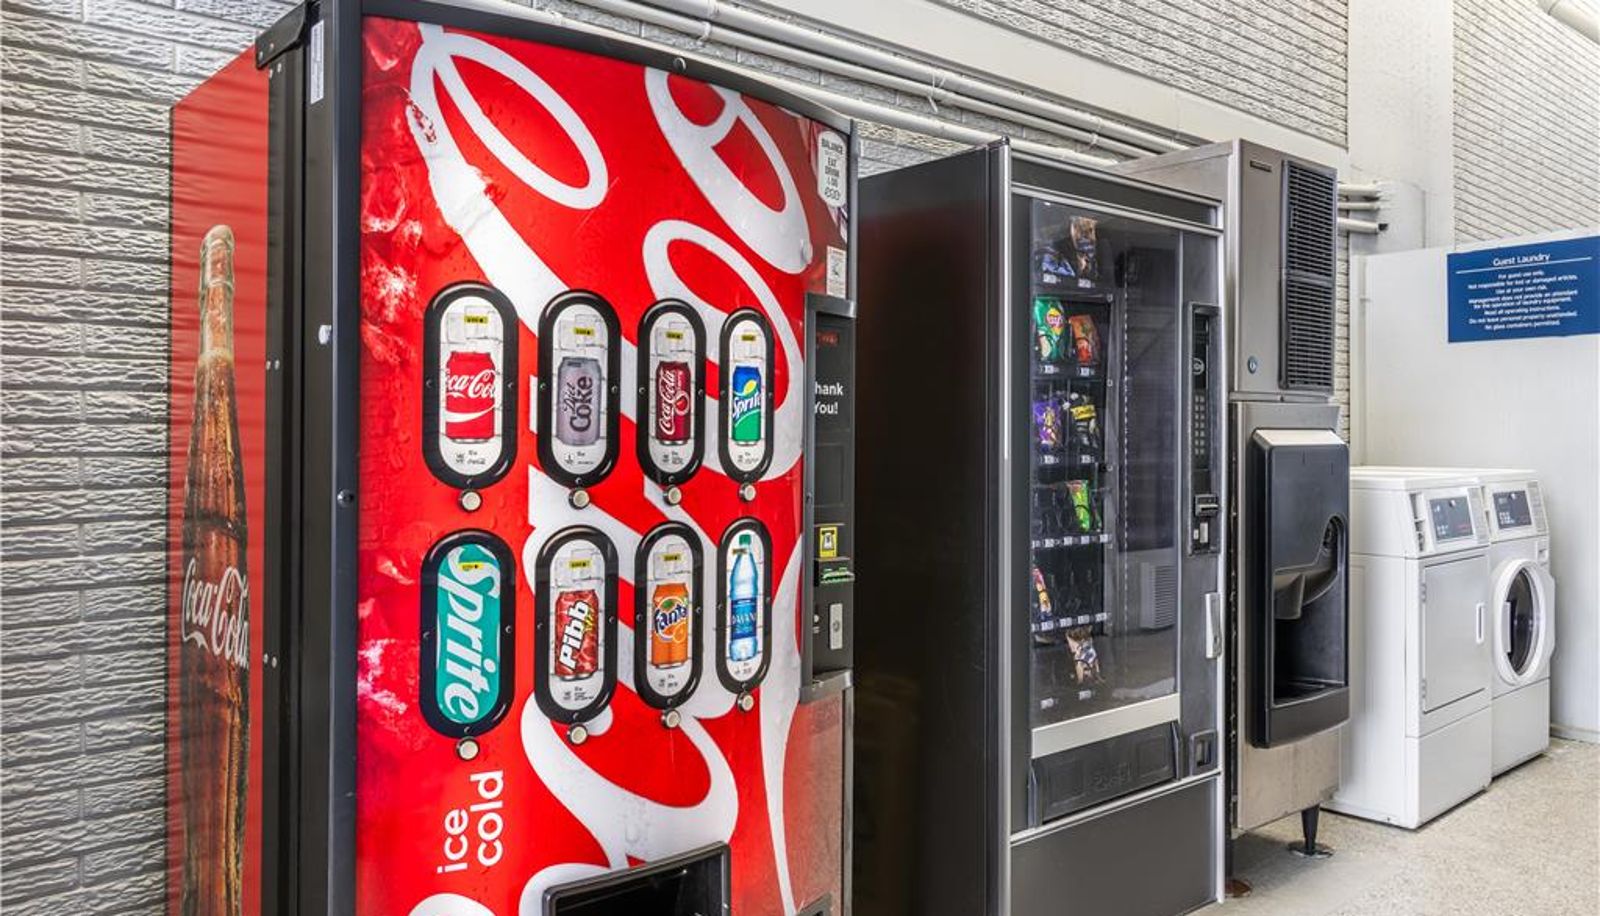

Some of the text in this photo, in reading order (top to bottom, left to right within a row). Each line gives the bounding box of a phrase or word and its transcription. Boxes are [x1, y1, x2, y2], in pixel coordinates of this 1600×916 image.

[1493, 254, 1550, 266] Guest Laundry
[564, 382, 576, 414] Diet
[570, 376, 592, 432] Coke
[658, 367, 677, 435] Coca-Cola
[814, 402, 838, 414] You!
[815, 380, 844, 396] hank
[182, 558, 250, 670] Coca-Cola
[438, 546, 501, 720] Sprite
[558, 602, 590, 668] Pibb
[655, 603, 688, 633] Fanta
[437, 808, 468, 874] ice
[470, 770, 504, 866] cold
